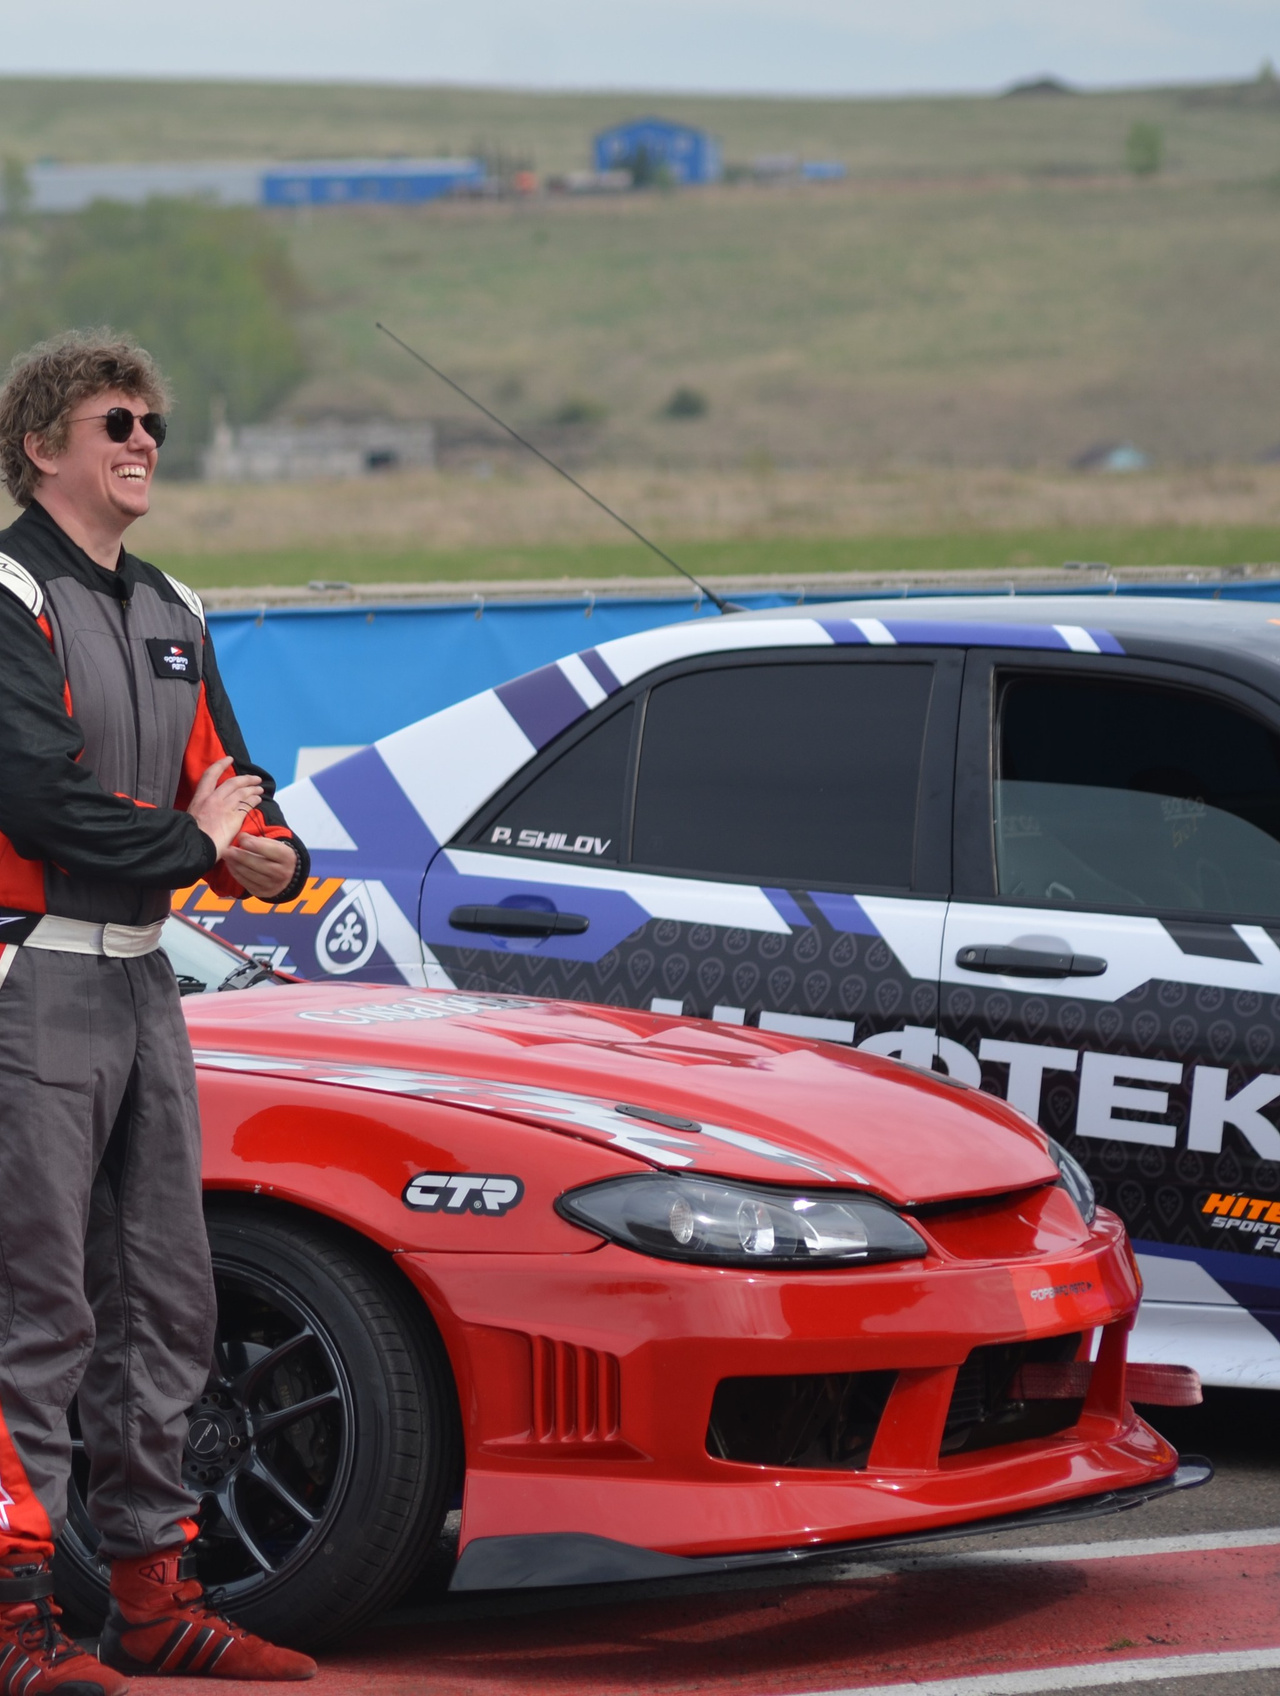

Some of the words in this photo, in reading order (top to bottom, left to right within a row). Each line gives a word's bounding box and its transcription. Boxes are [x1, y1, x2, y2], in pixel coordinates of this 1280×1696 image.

[491, 826, 513, 845] P.
[516, 829, 612, 855] SHILOV
[406, 1174, 518, 1210] CTR
